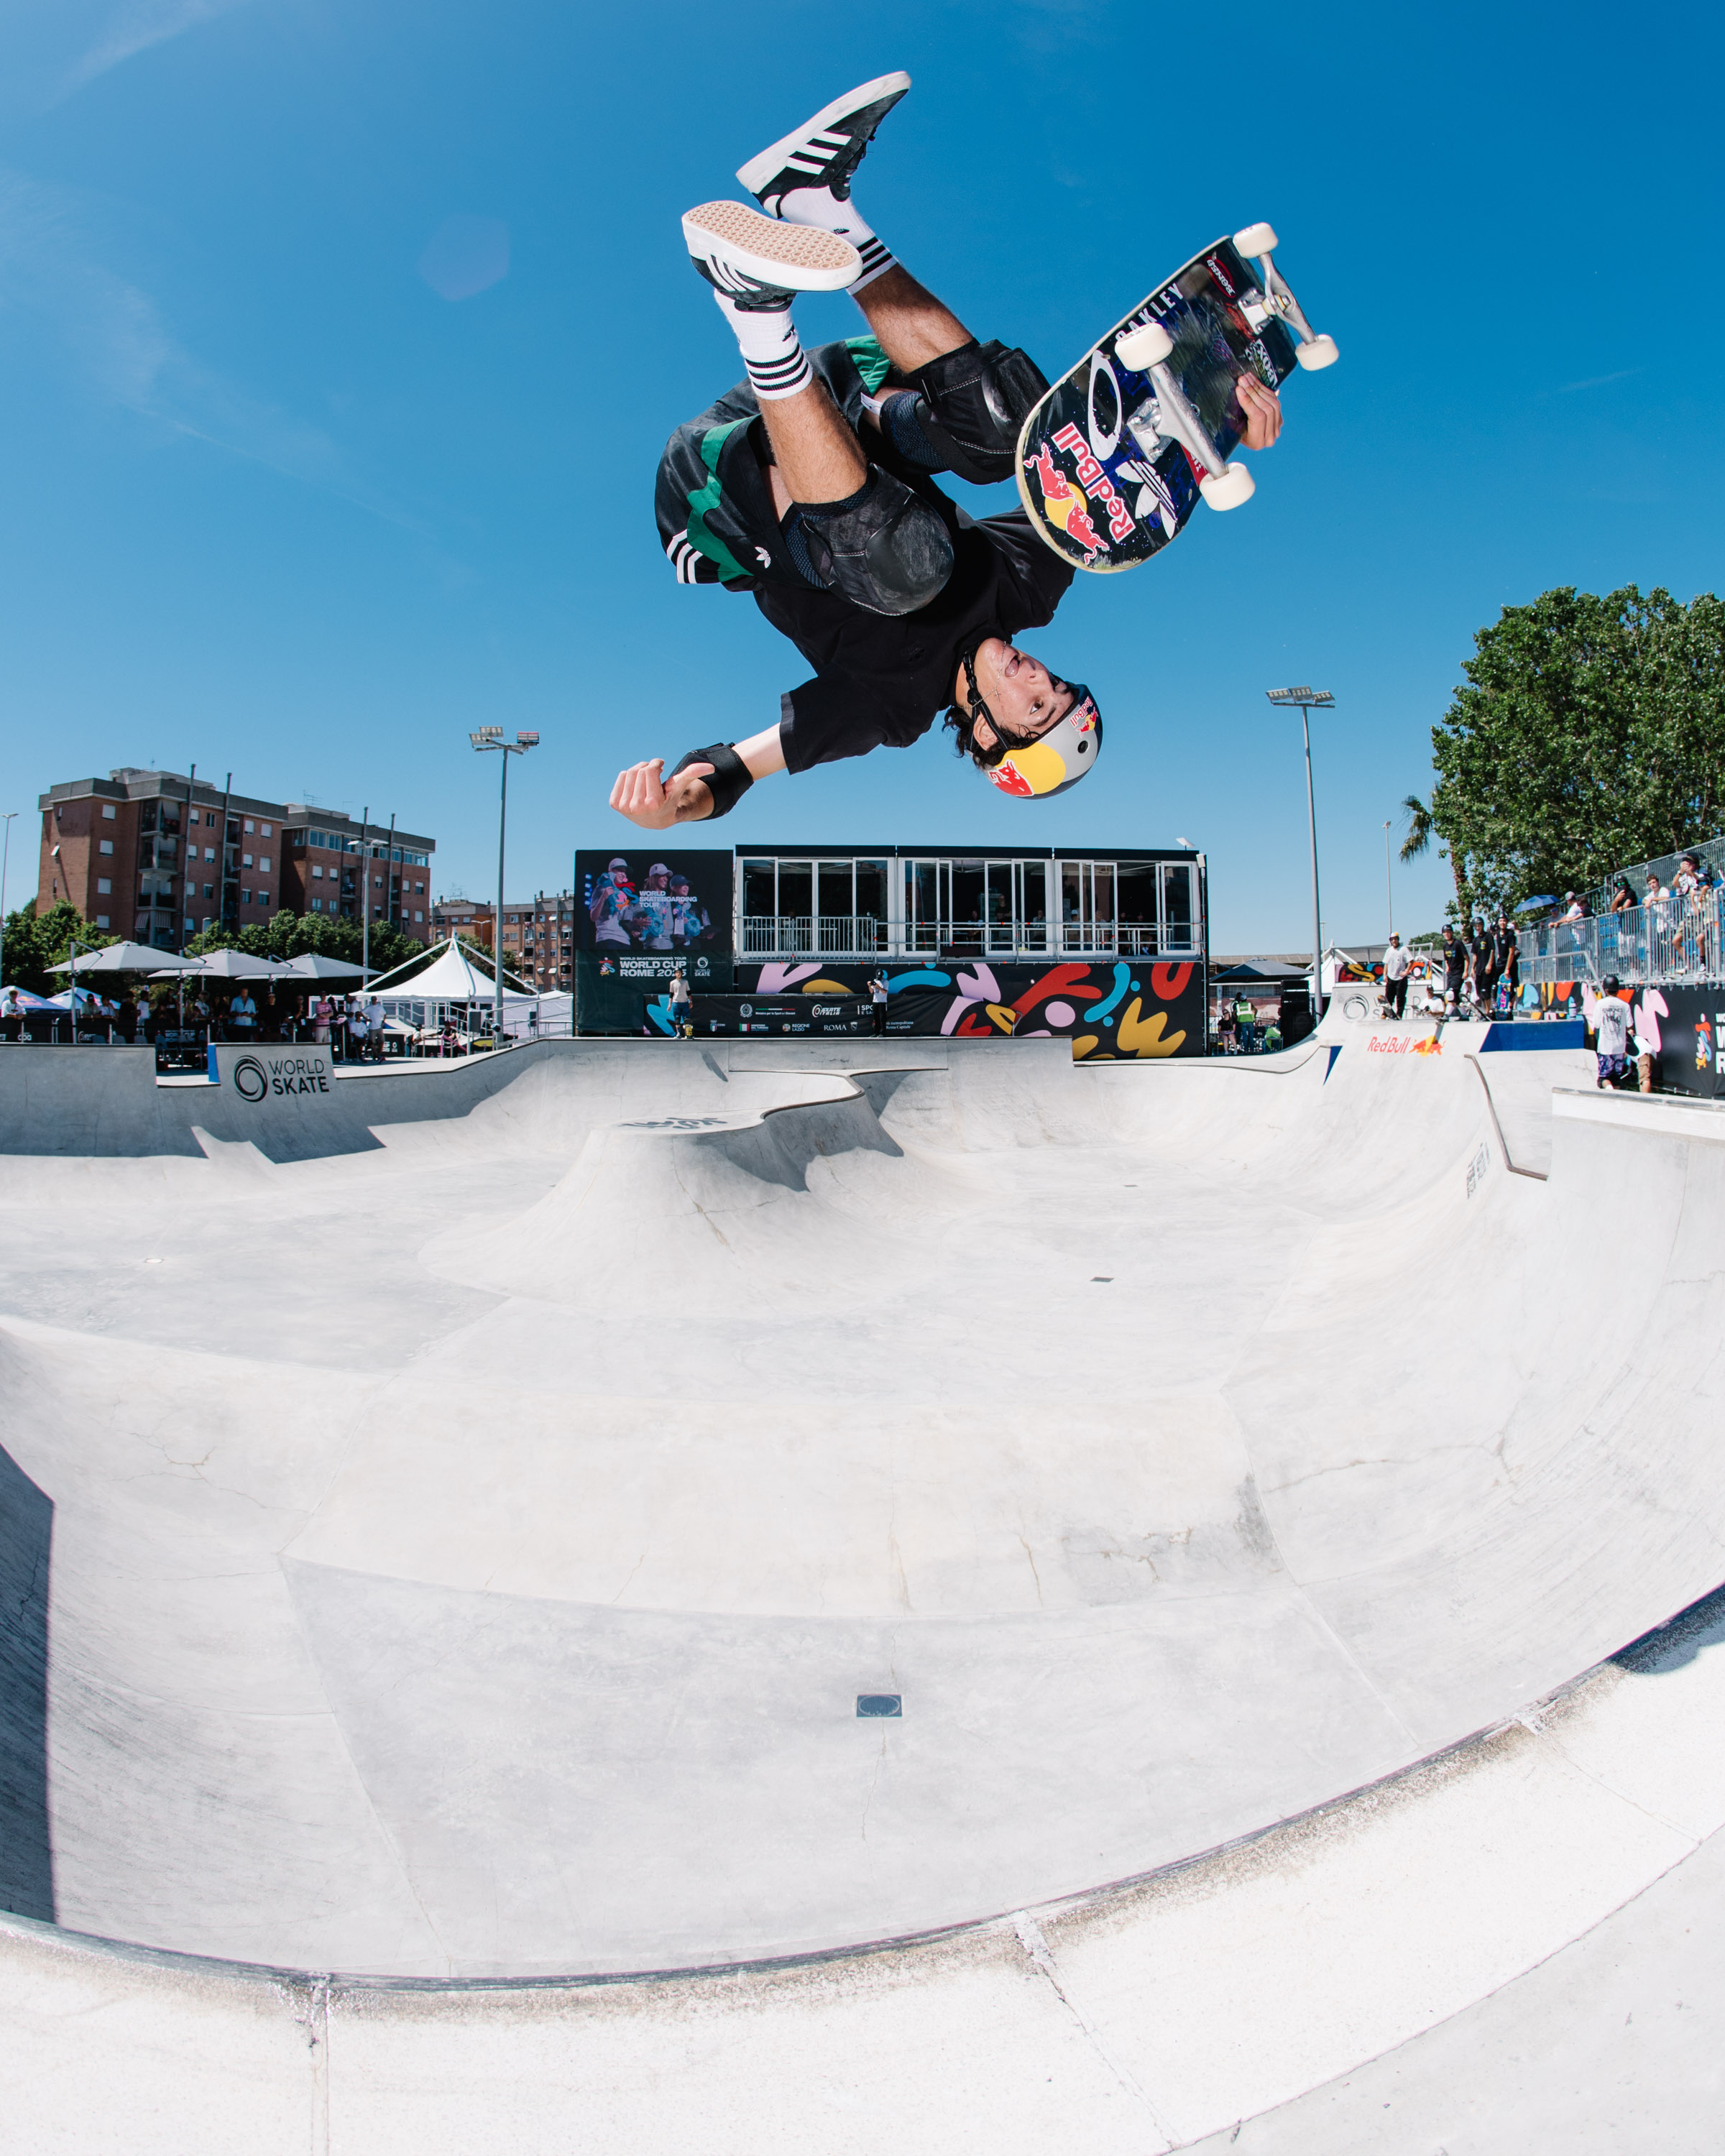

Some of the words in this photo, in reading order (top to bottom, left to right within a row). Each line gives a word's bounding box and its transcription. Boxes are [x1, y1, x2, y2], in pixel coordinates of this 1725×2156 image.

[1115, 282, 1184, 341] OAKLEY
[1256, 344, 1275, 384] BOX
[268, 1059, 325, 1075] WORLD
[272, 1077, 330, 1095] SKATE
